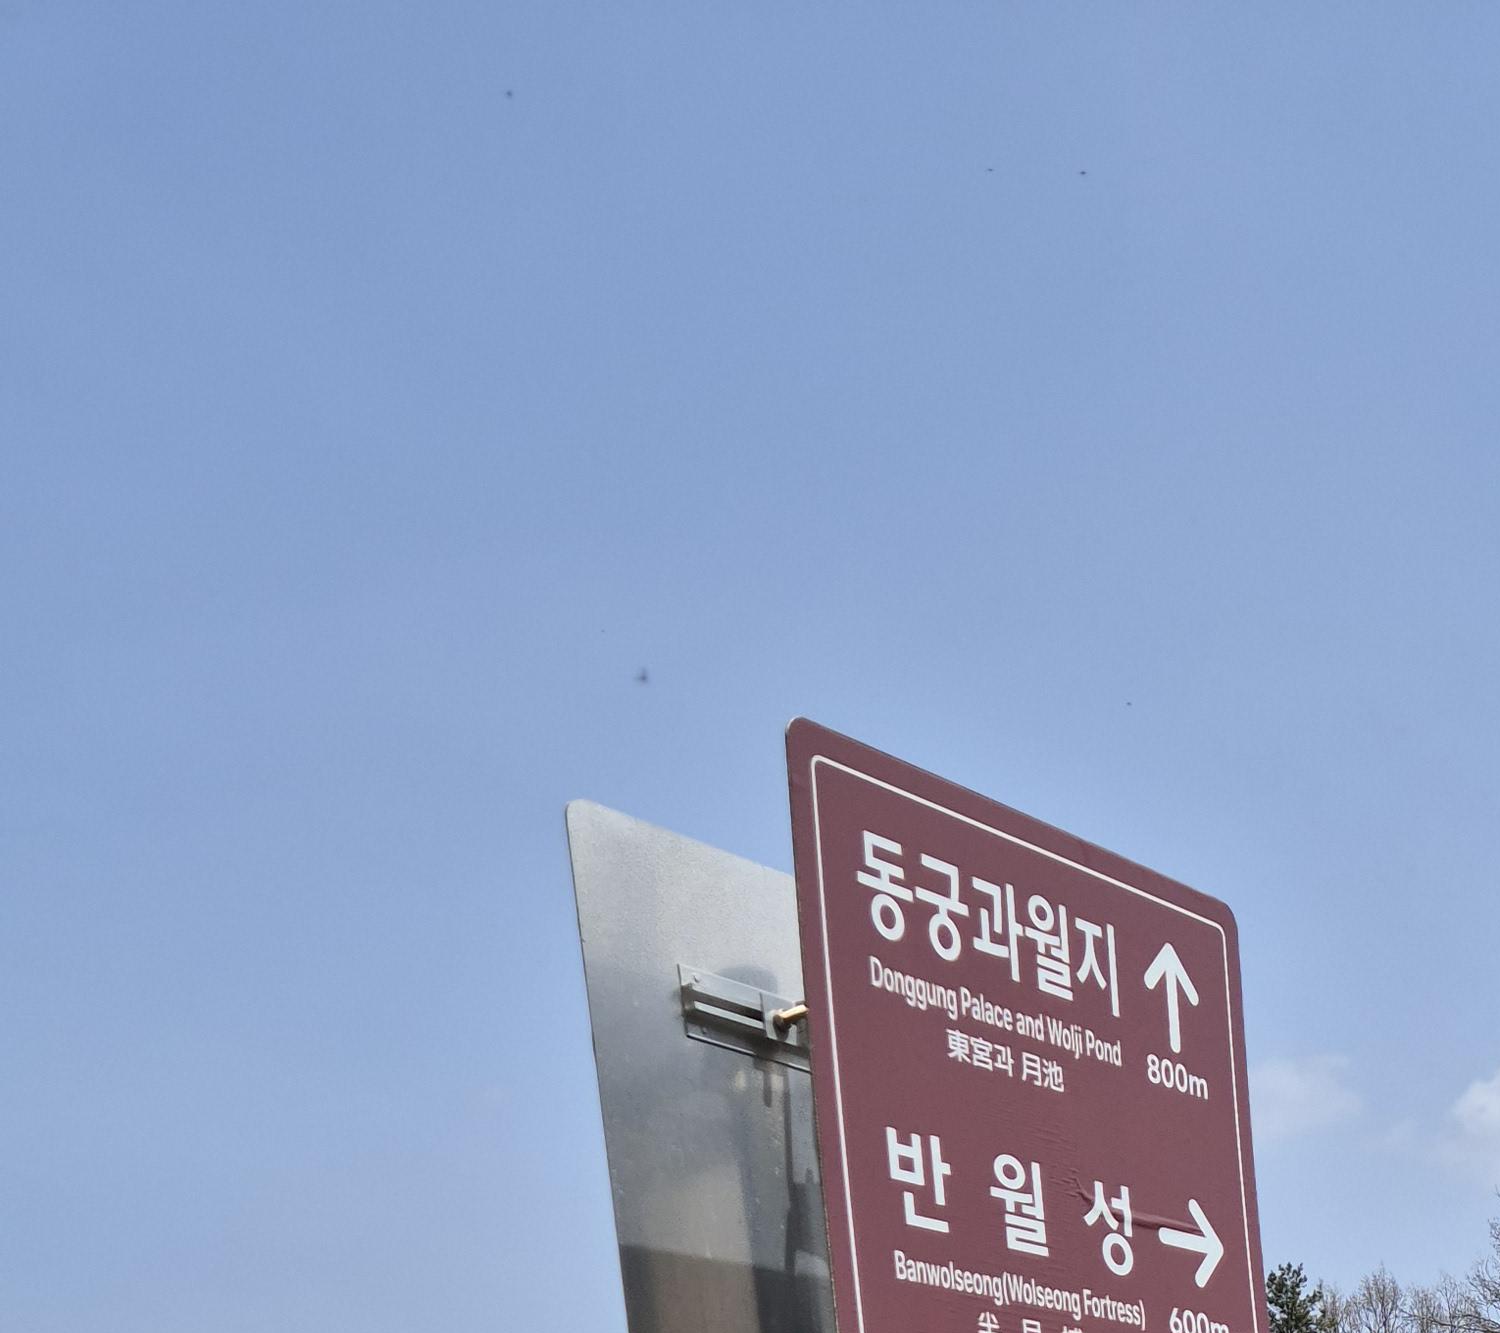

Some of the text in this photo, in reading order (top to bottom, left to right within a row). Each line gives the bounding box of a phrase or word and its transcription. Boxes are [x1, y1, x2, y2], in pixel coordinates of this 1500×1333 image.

[855, 828, 1122, 1019] 동궁과월지
[868, 954, 1124, 1068] Donggung Palace and Wolji Pond
[1145, 1052, 1210, 1101] 800m
[892, 1248, 1147, 1332] Banwolseong(Wolseong Fortress)
